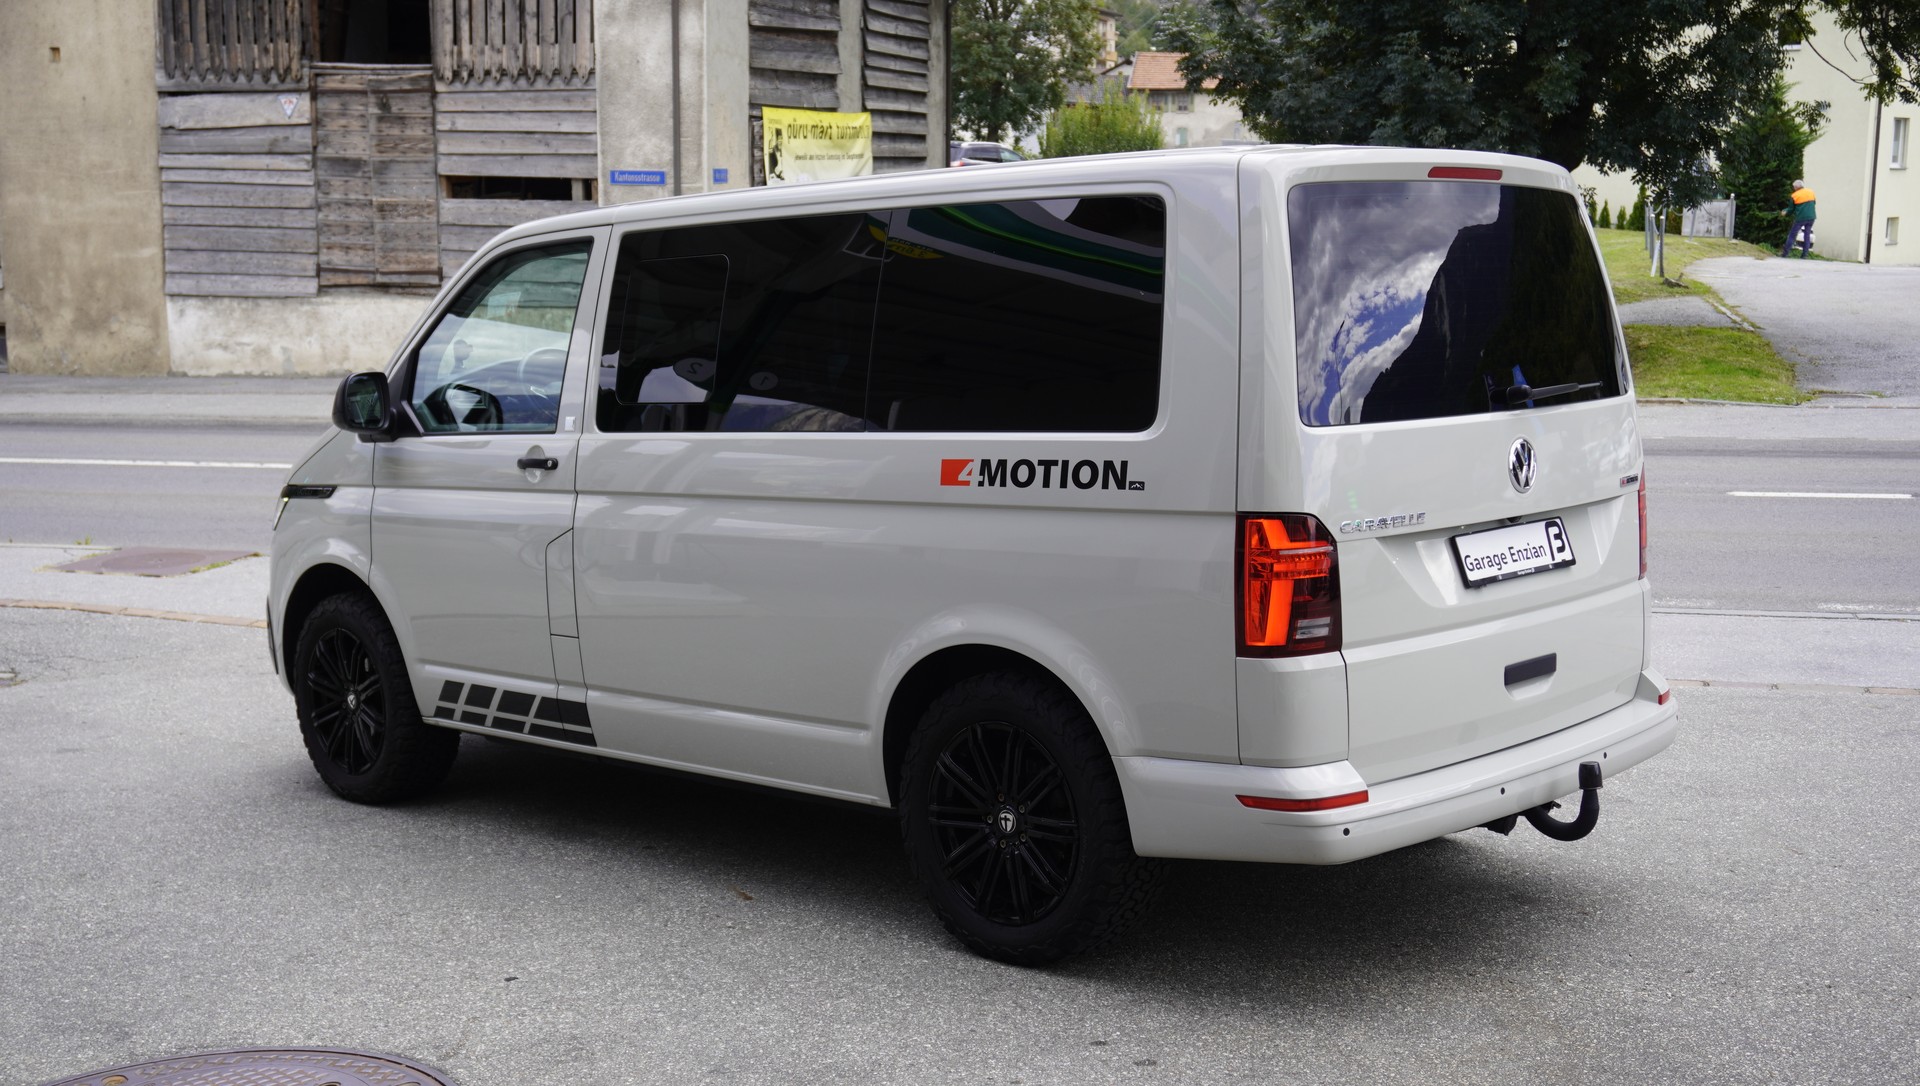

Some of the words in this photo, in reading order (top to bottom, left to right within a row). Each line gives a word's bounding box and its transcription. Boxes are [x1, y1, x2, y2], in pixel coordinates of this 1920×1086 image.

[614, 171, 661, 182] Kantonsstrasse
[1339, 512, 1426, 534] CARAVELLE
[1464, 551, 1508, 572] Garage
[1508, 543, 1547, 563] Enzian
